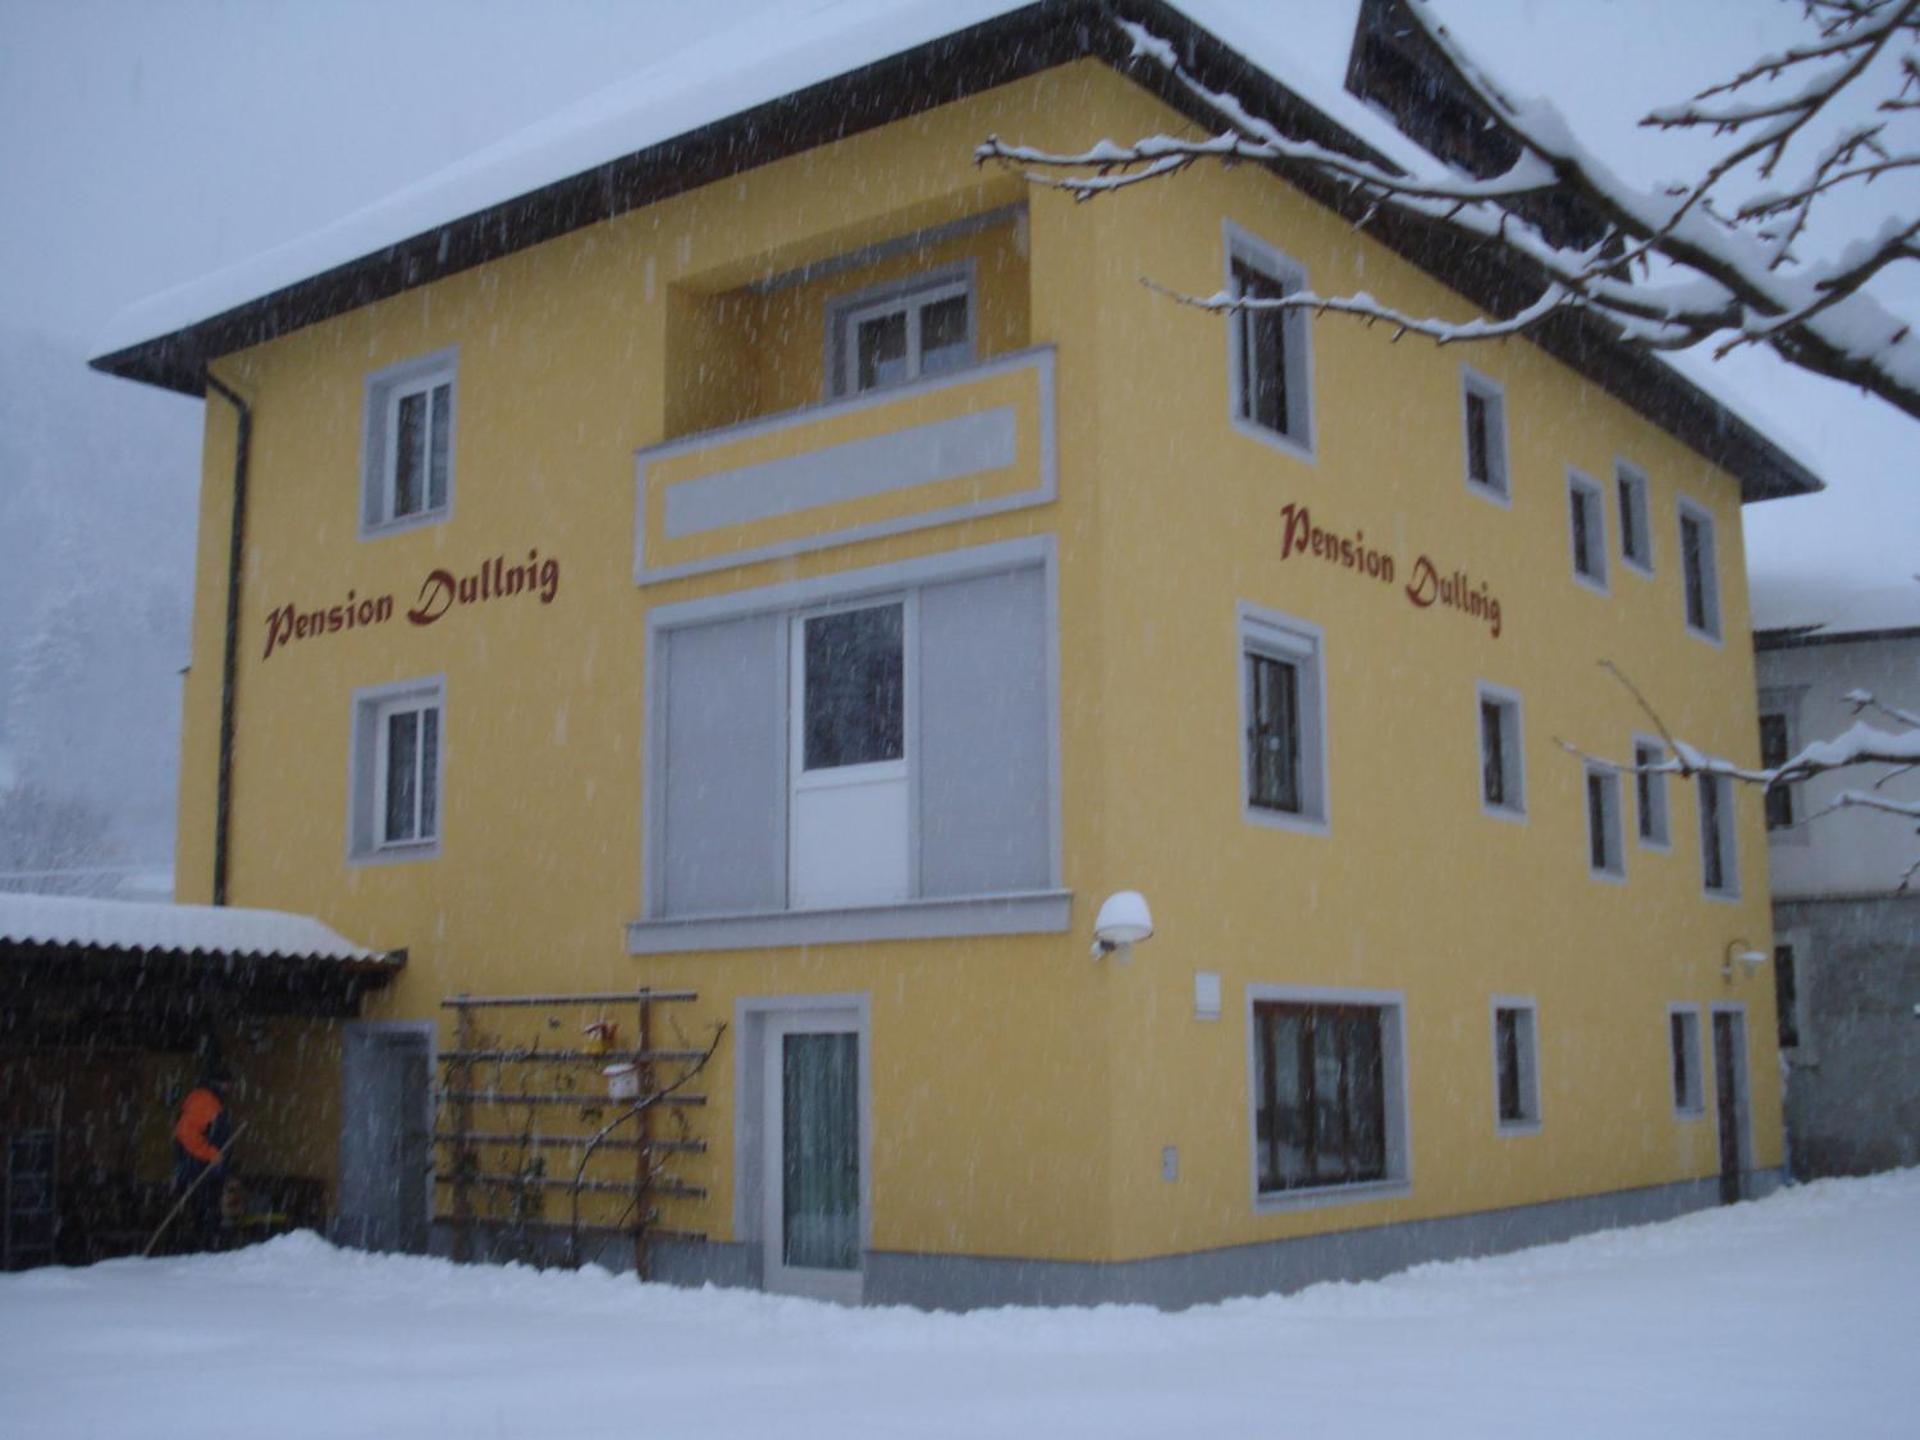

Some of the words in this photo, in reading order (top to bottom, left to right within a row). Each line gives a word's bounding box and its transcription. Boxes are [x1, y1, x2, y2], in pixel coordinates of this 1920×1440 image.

[262, 589, 395, 662] Pension
[406, 547, 560, 627] Dullnig
[1279, 502, 1396, 585] Pension
[1404, 553, 1503, 640] Dullnig
